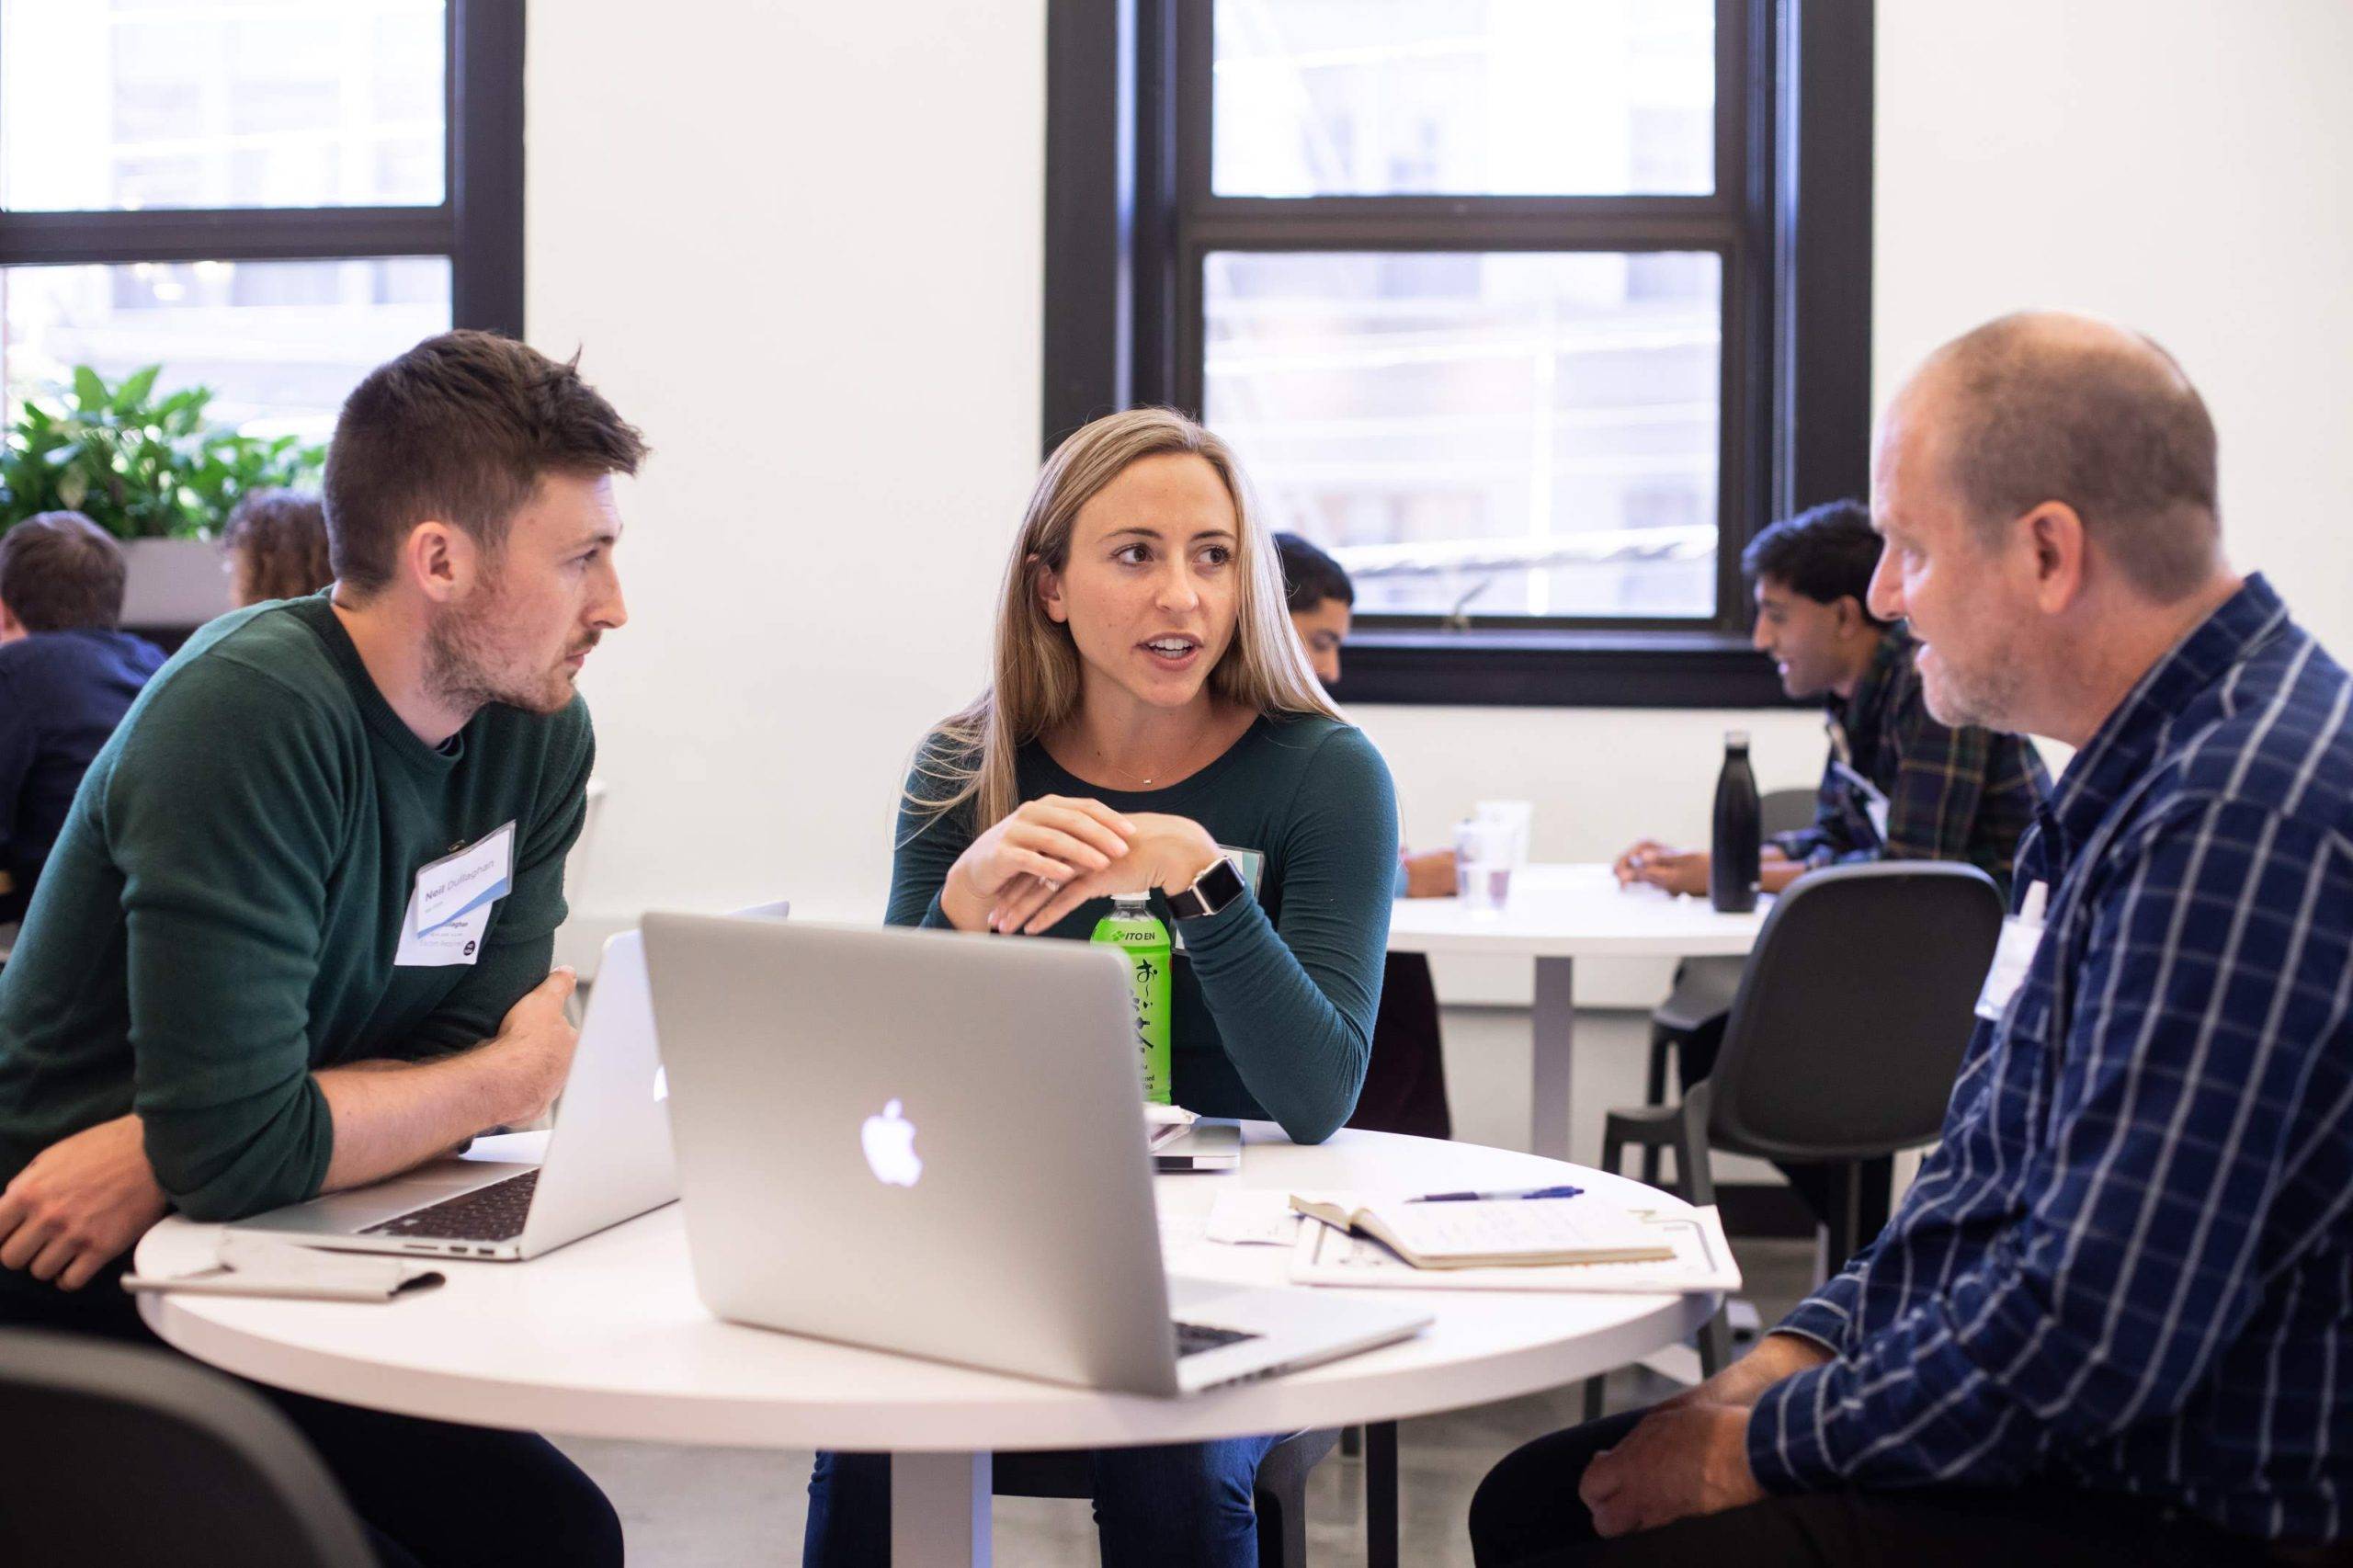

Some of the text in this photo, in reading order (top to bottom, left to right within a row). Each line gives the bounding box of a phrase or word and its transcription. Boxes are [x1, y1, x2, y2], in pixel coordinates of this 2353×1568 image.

[426, 884, 446, 902] Neil
[1125, 932, 1155, 940] ITO EN
